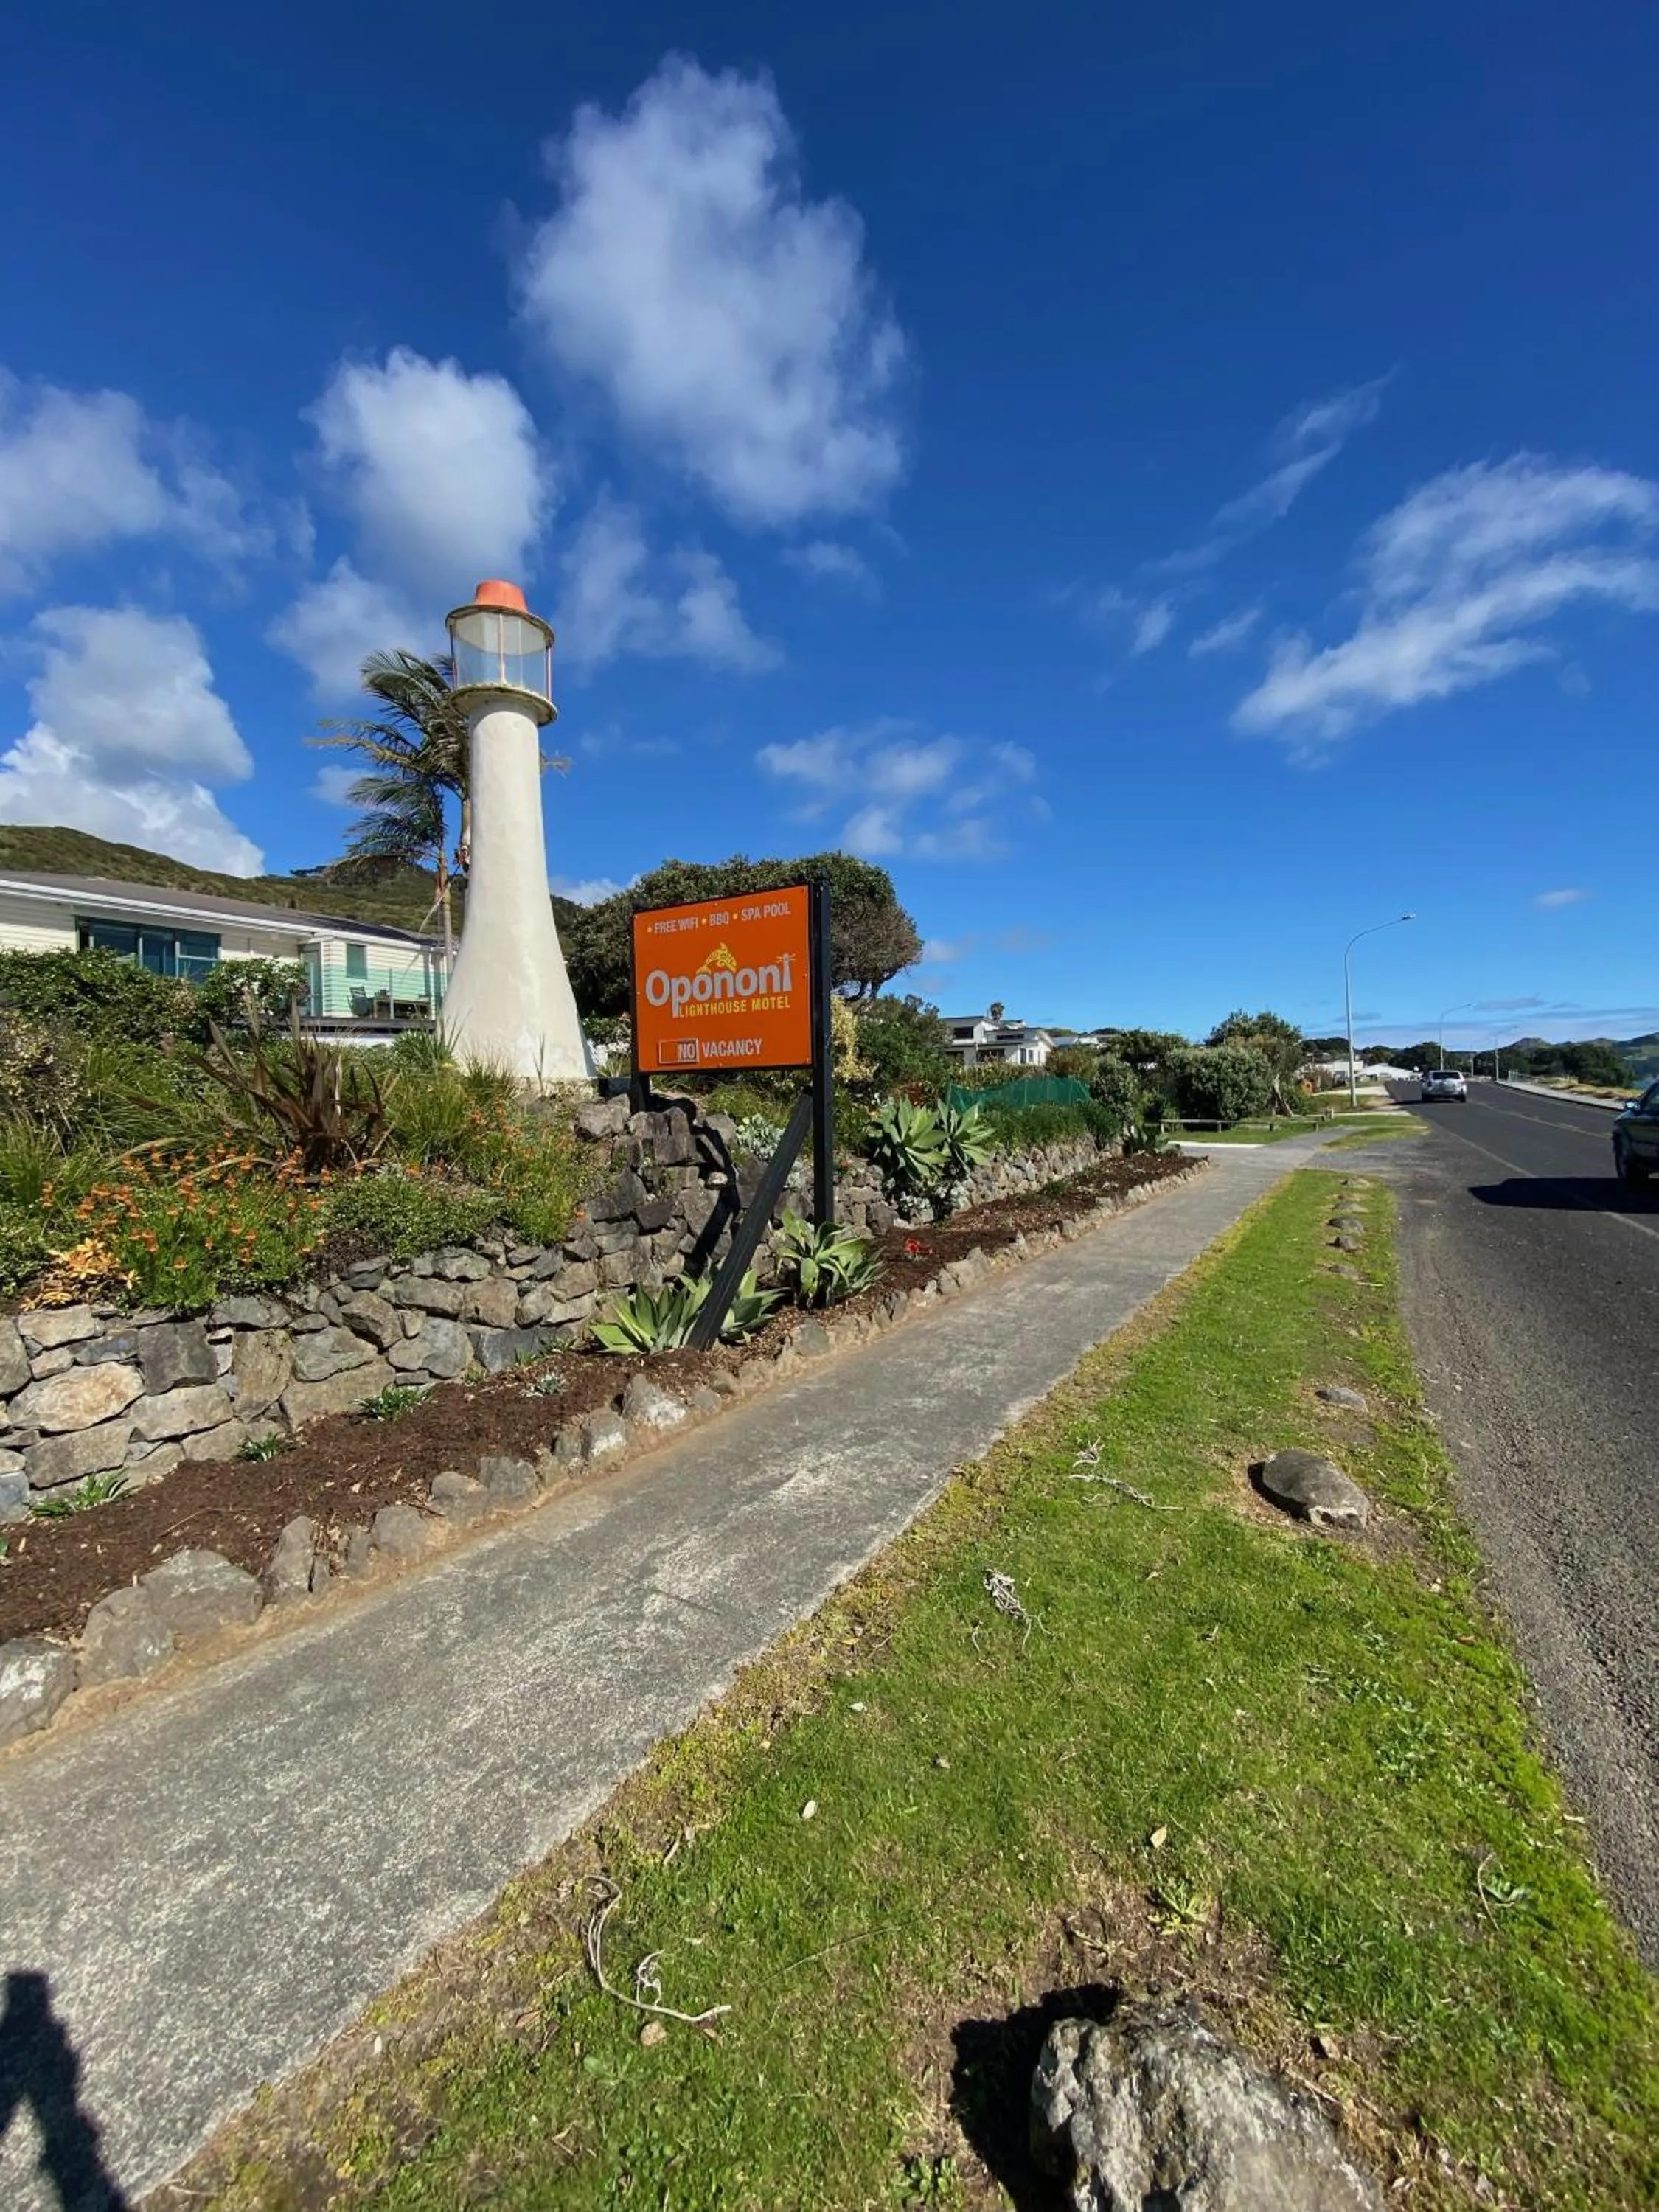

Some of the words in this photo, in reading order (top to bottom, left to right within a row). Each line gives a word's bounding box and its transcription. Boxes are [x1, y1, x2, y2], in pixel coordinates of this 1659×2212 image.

[654, 920, 677, 934] FREE
[678, 917, 698, 931] WIFI
[741, 907, 762, 921] SPA
[763, 902, 791, 917] POOL
[645, 953, 793, 1018] Opononi
[679, 999, 747, 1018] LIGHTHOUSE
[751, 995, 791, 1012] MOTEL
[678, 1043, 696, 1060] NO
[701, 1038, 763, 1058] VACANCY
